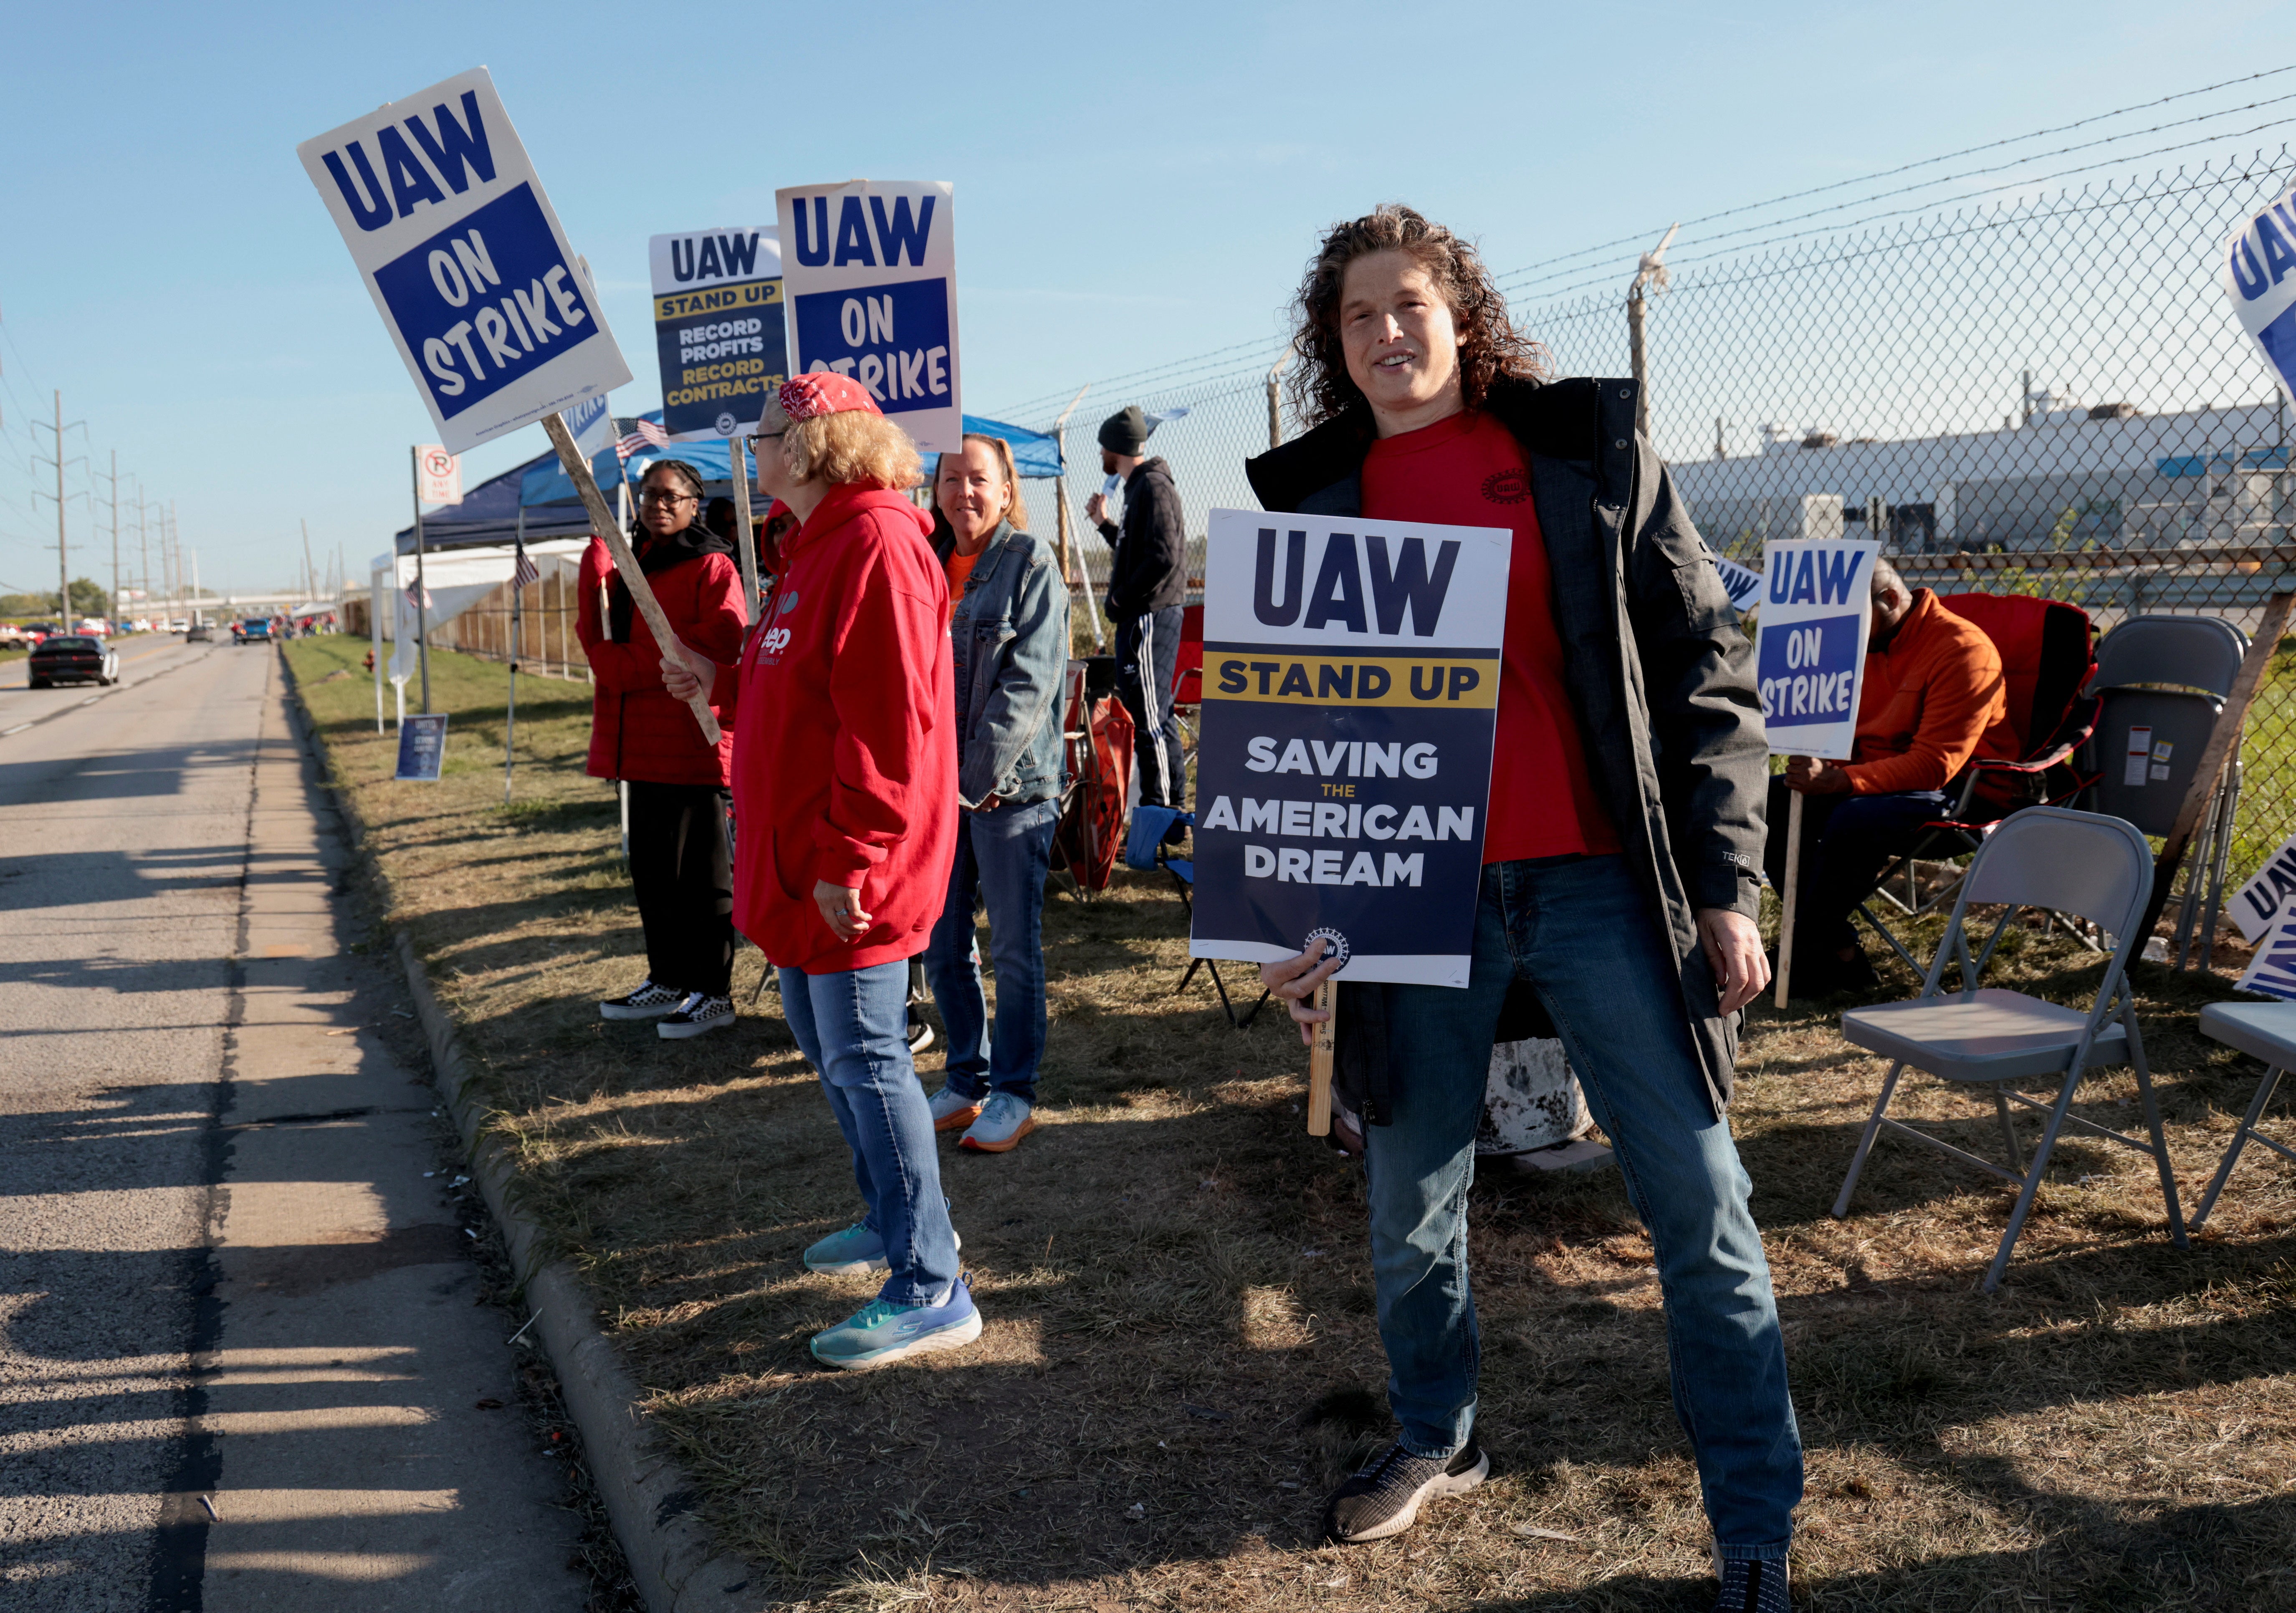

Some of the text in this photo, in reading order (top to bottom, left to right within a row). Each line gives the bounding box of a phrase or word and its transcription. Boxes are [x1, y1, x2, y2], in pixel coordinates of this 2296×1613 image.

[321, 90, 496, 231] UAW
[792, 196, 936, 267] UAW
[2231, 191, 2296, 300] UA
[428, 229, 501, 307] ON
[672, 233, 759, 282] UAW
[662, 285, 775, 316] STAND UP
[841, 294, 893, 347] ON
[423, 264, 586, 396] STRIKE
[680, 318, 762, 346] RECORD
[681, 336, 764, 363] PROFITS
[668, 374, 785, 406] CONTRACTS
[683, 358, 764, 384] RECORD
[1254, 528, 1461, 637] UAW
[1770, 550, 1865, 605] UAW
[1787, 627, 1822, 669] ON
[1217, 660, 1479, 701] STAND UP
[1760, 670, 1853, 718] STRIKE
[1244, 736, 1438, 779] SAVING
[1322, 784, 1355, 798] THE
[1202, 795, 1474, 841] AMERICAN
[1245, 845, 1424, 887] DREAM
